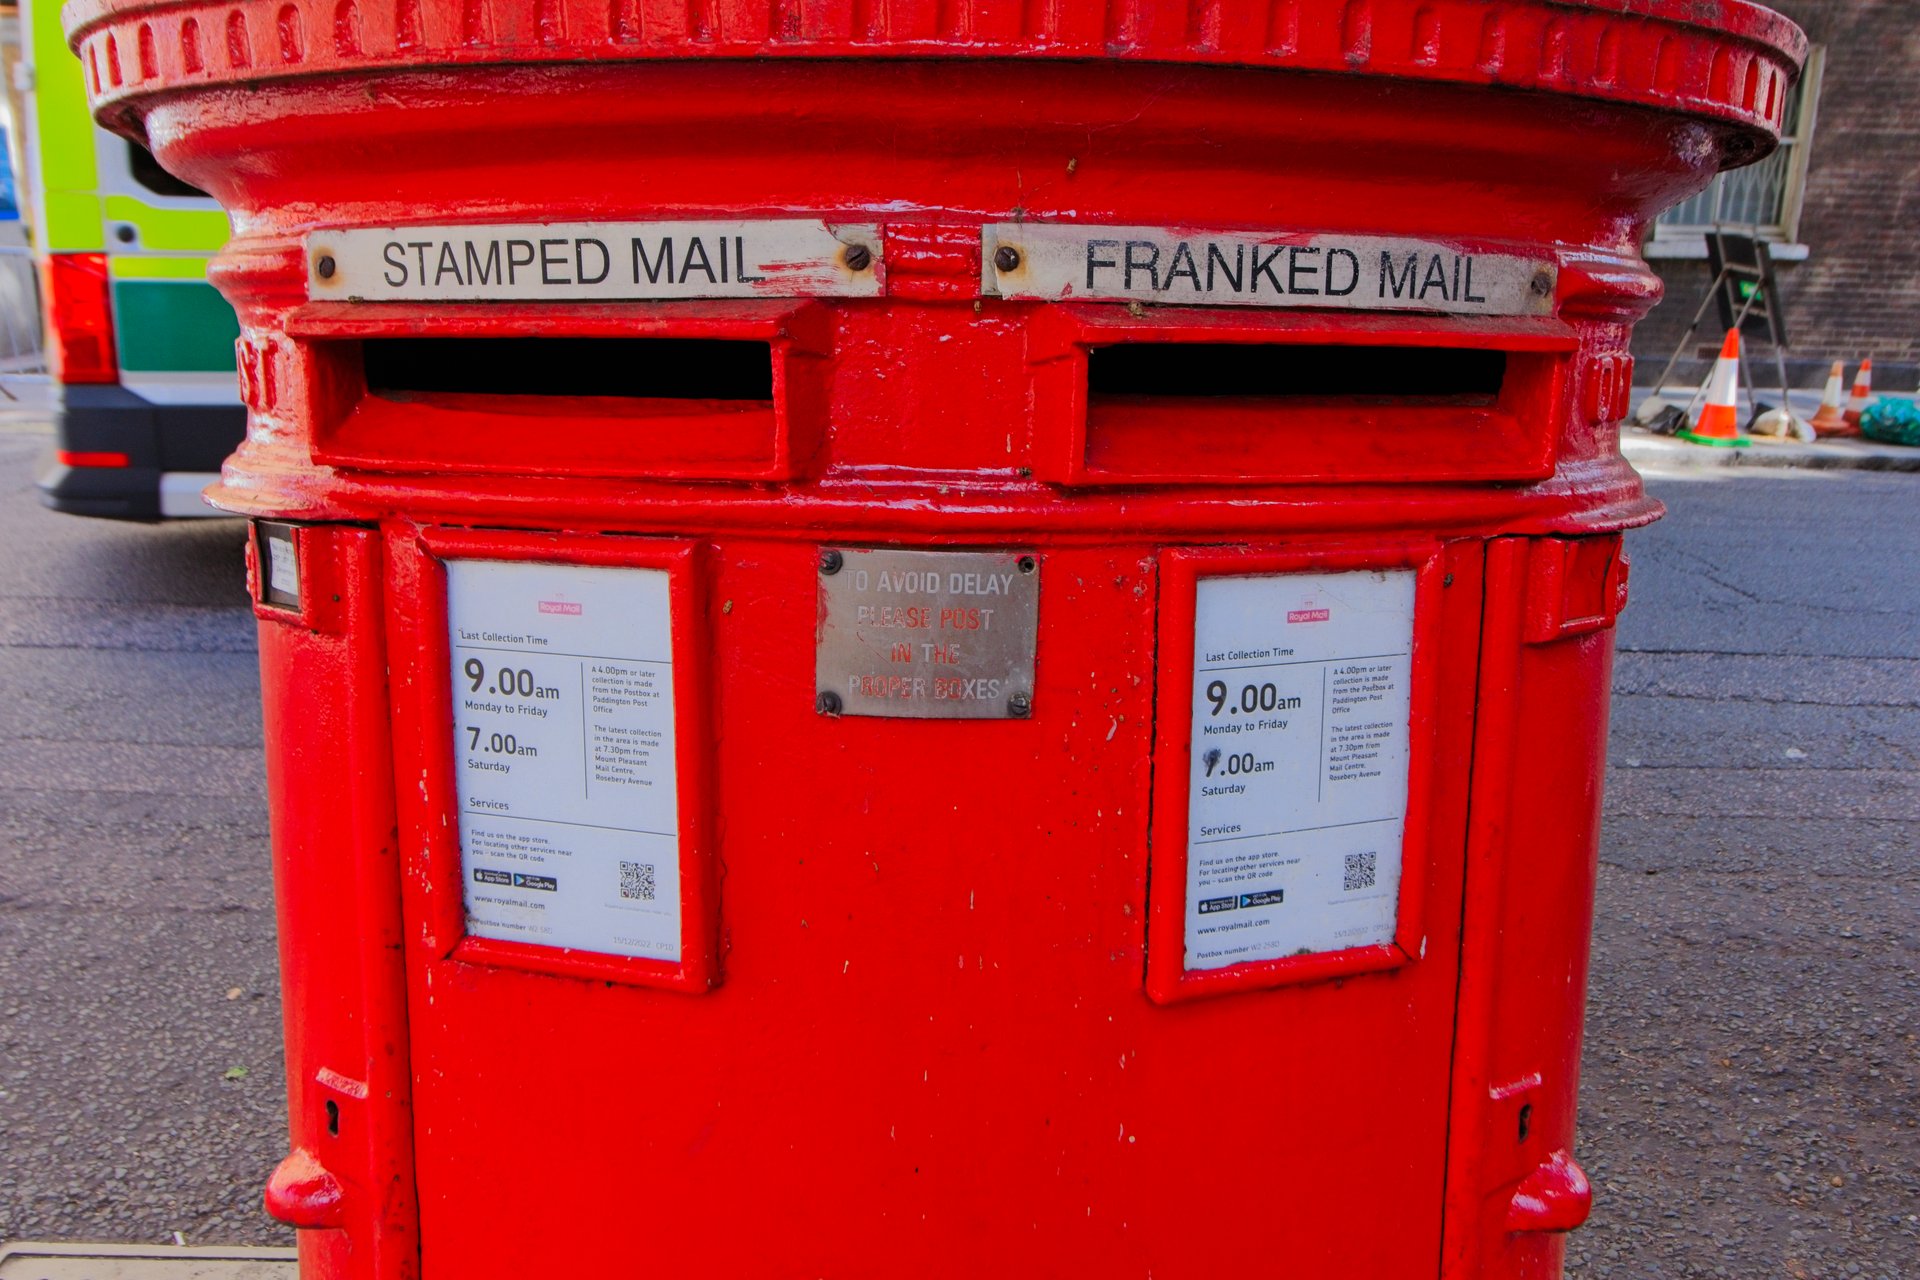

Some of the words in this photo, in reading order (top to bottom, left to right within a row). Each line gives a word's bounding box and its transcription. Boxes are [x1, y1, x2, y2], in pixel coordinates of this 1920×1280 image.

[383, 238, 610, 288] STAMPED
[631, 235, 766, 286] MAIL
[1085, 239, 1361, 298] FRANKED
[1378, 249, 1487, 304] MAIL
[843, 568, 868, 592] TO
[876, 570, 940, 594] AVOID
[949, 572, 1014, 596] DELAY
[540, 602, 561, 613] Royal
[562, 604, 580, 614] Mail
[857, 605, 932, 630] PLEASE
[939, 607, 994, 631] POST
[1289, 612, 1310, 622] Royal
[1311, 610, 1328, 620] Mail
[461, 631, 480, 641] Last
[482, 632, 524, 644] Collection
[527, 635, 548, 646] Time
[891, 642, 912, 664] IN
[920, 643, 961, 665] THE
[1206, 652, 1225, 662] Last
[1228, 649, 1270, 661] Collection
[1272, 646, 1294, 657] Time
[598, 666, 628, 676] 4.00pm
[640, 669, 656, 678] later
[1339, 666, 1367, 675] 4.00pm
[464, 657, 560, 700] 9.00am
[592, 677, 624, 685] collection
[634, 680, 653, 688] made
[1333, 677, 1363, 685] collection
[592, 686, 609, 694] from
[610, 687, 622, 695] the
[624, 688, 651, 697] Postbox
[848, 674, 926, 699] PROPER
[934, 676, 1001, 700] BOXES
[1333, 687, 1348, 695] from
[1362, 684, 1386, 692] Postbox
[593, 695, 631, 706] Paddington
[633, 699, 648, 707] Post
[1206, 679, 1301, 717] 9.00am
[1332, 695, 1367, 705] Paddington
[465, 700, 501, 714] Monday
[505, 704, 515, 714] to
[518, 704, 548, 718] Friday
[593, 705, 613, 714] Office
[1332, 706, 1350, 714] Office
[594, 724, 606, 733] The
[609, 726, 628, 734] latest
[630, 728, 662, 738] collection
[1203, 721, 1242, 736] Monday
[1245, 721, 1255, 731] to
[1258, 718, 1288, 731] Friday
[1364, 721, 1393, 730] collection
[466, 726, 538, 757] 7.00am
[602, 735, 614, 743] the
[603, 745, 631, 755] 7.30pm
[633, 748, 649, 757] from
[1339, 743, 1364, 752] 7.30pm
[595, 755, 616, 763] Mount
[618, 757, 648, 767] Pleasant
[1330, 754, 1350, 762] Mount
[1352, 752, 1378, 760] Pleasant
[468, 759, 511, 774] Saturday
[595, 764, 610, 772] Mail
[1329, 764, 1343, 772] Mail
[595, 773, 626, 785] Rosebery
[627, 777, 653, 786] Avenue
[1329, 772, 1357, 781] Rosebery
[1358, 770, 1381, 778] Avenue
[1202, 783, 1246, 797] Saturday
[470, 797, 510, 811] Services
[472, 829, 485, 837] Find
[506, 833, 517, 841] the
[1200, 823, 1241, 837] Services
[472, 838, 481, 846] For
[484, 840, 509, 850] locating
[530, 846, 556, 855] services
[472, 849, 484, 857] you
[1199, 859, 1213, 867] Find
[1199, 869, 1209, 877] For
[1212, 866, 1238, 875] locating
[1239, 863, 1257, 872] other
[1259, 860, 1285, 869] services
[1198, 879, 1211, 887] you
[1218, 876, 1233, 884] scan
[1247, 872, 1256, 880] QR
[1258, 870, 1273, 878] code
[474, 896, 546, 910] www.royalmail.com
[501, 921, 527, 931] number
[1197, 919, 1270, 935] www.royalmail.com
[1196, 951, 1222, 959] Postbox
[1224, 946, 1249, 955] number
